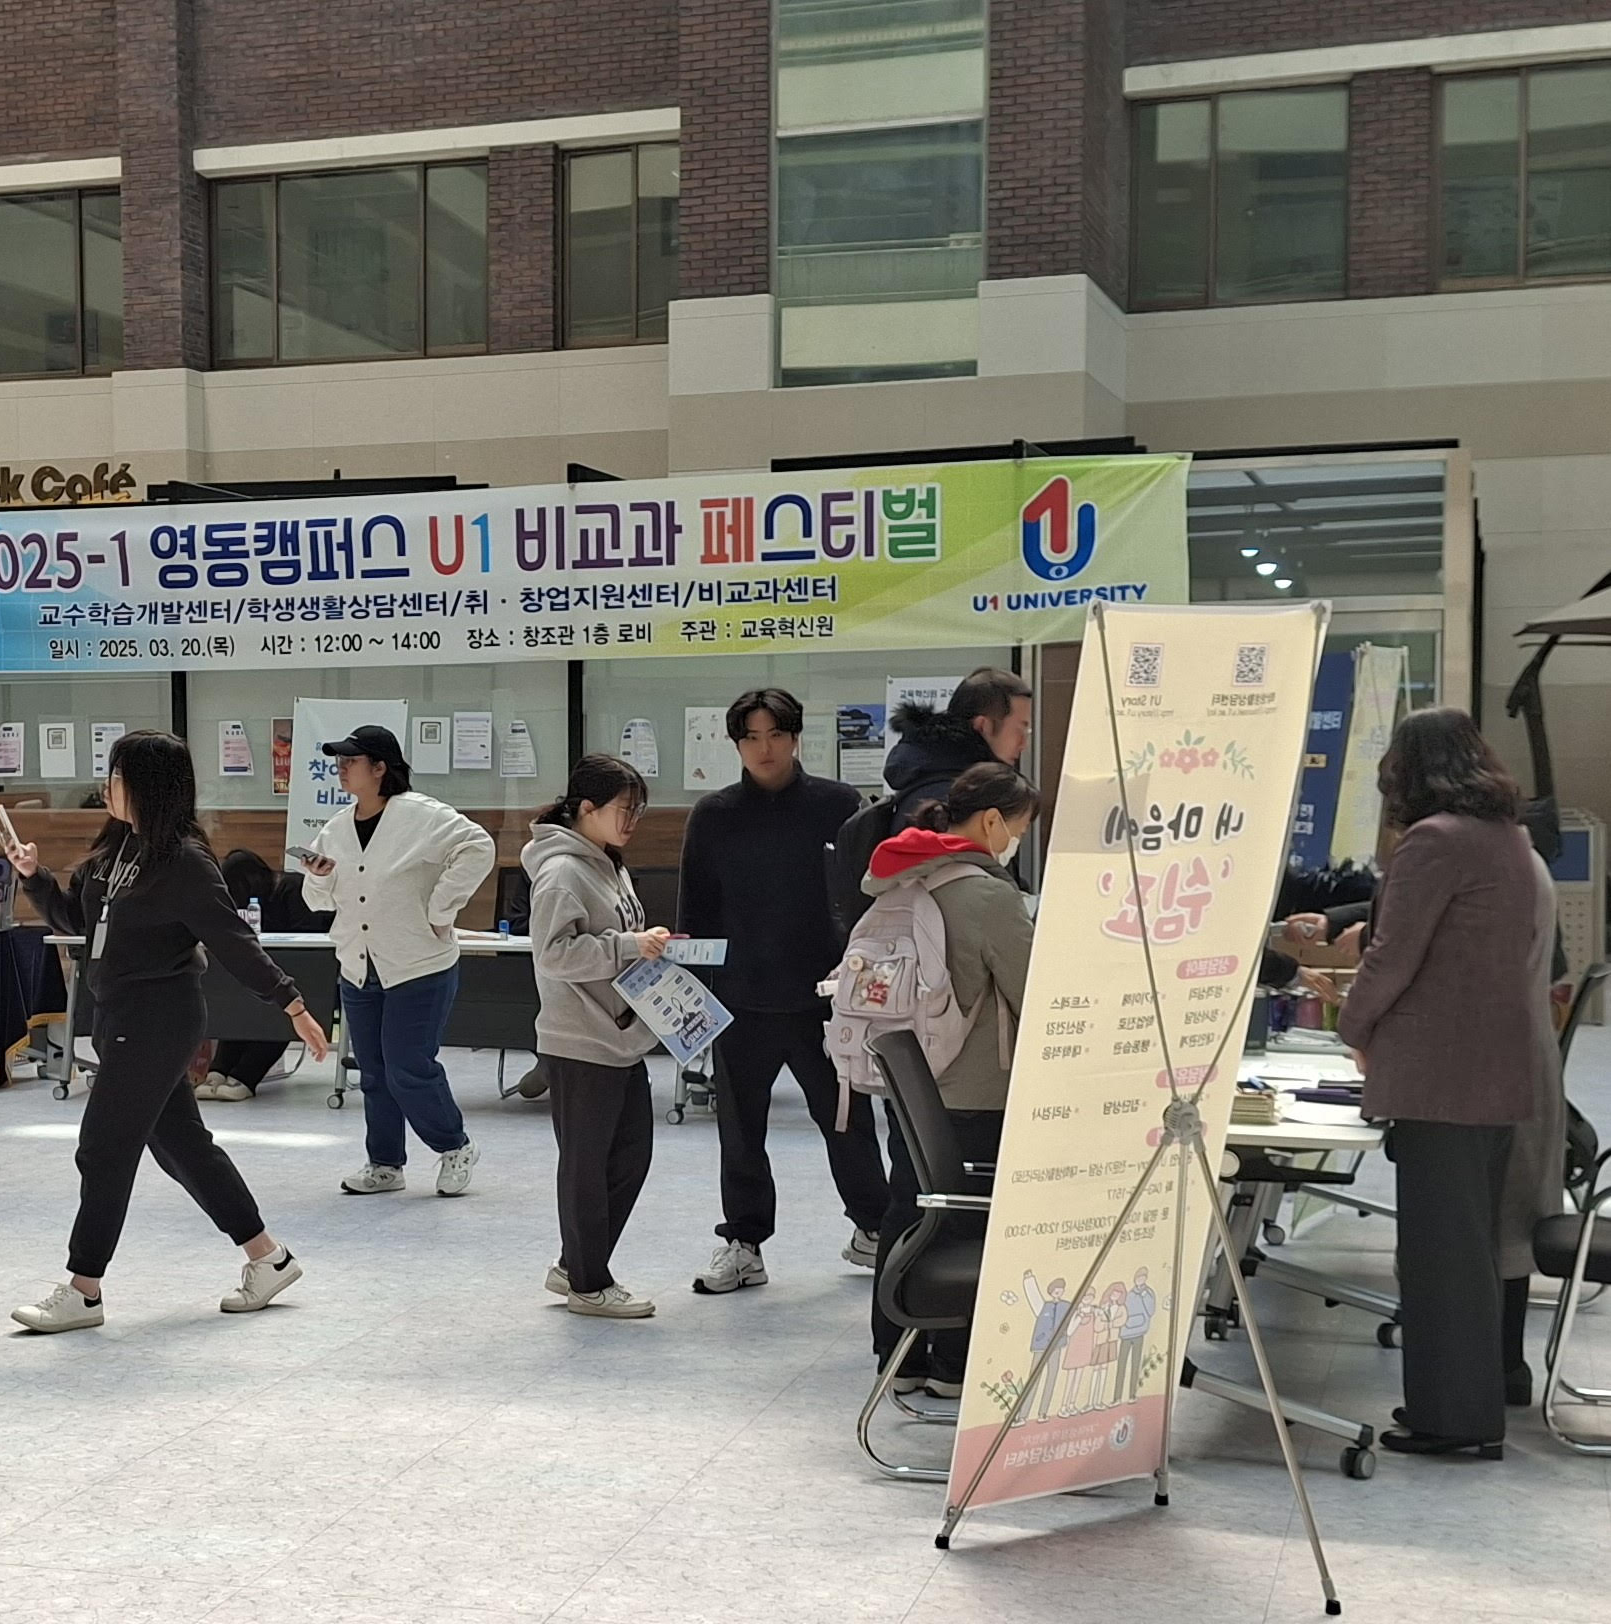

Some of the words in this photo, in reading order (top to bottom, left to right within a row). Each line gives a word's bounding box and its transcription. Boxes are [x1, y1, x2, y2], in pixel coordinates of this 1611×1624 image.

[31, 460, 138, 504] Café
[149, 513, 411, 590] 영동캠퍼스
[428, 507, 491, 577] U1
[514, 498, 684, 572] 비교과
[699, 482, 942, 565] 페스티벌
[38, 586, 489, 629] 교수학습개발센터/학생생활상담센터/취
[518, 575, 838, 615] 창업지원센터/비교과센터
[973, 595, 1001, 614] U1
[1006, 583, 1148, 612] UNIVERSITY
[48, 639, 81, 660] 일시
[98, 640, 142, 660] 2025.
[148, 639, 177, 659] 03.
[181, 637, 236, 660] 20.(목)
[261, 635, 292, 656] 시간
[314, 635, 364, 654] 12:00
[391, 631, 441, 652] 14:00
[465, 627, 502, 650] 장소
[521, 625, 575, 649] 창조관
[581, 624, 613, 646] 1층
[616, 622, 654, 645] 로비
[680, 619, 719, 643] 주관
[739, 613, 835, 641] 교육혁신원
